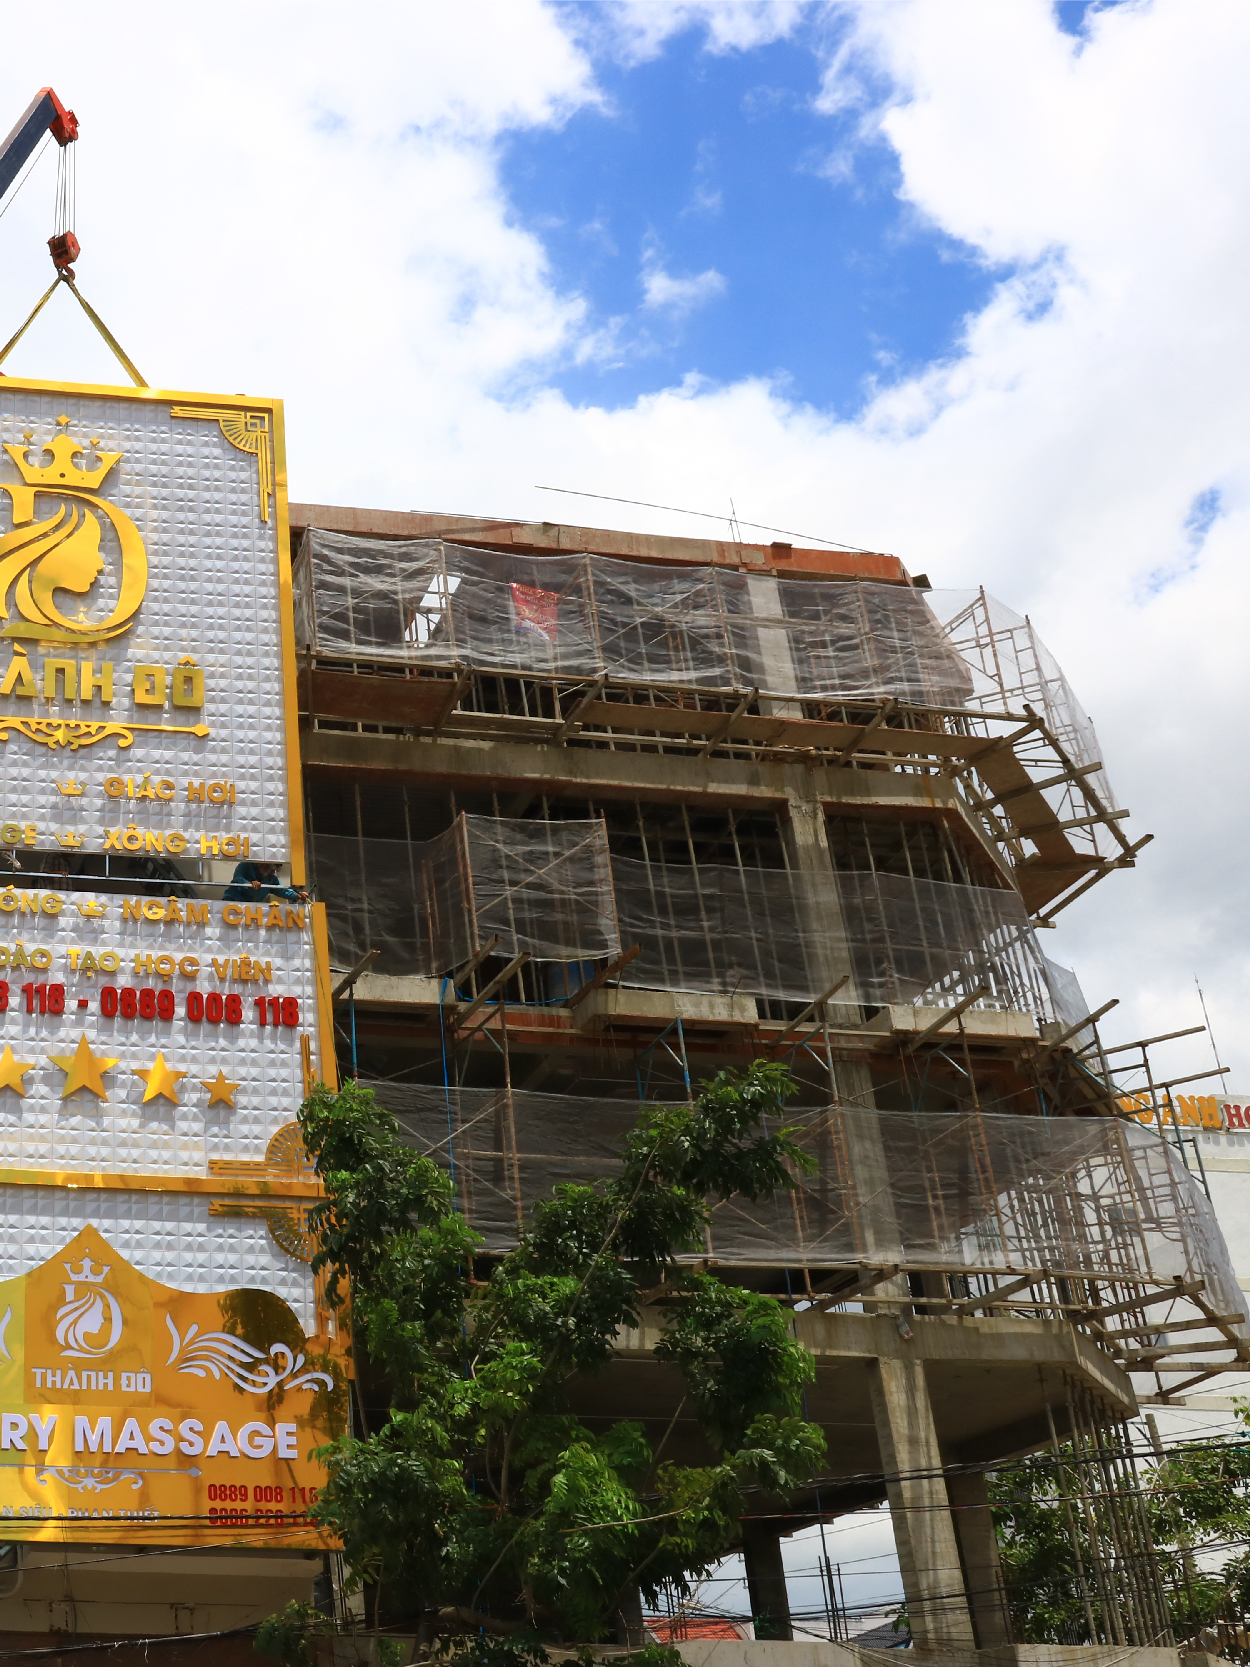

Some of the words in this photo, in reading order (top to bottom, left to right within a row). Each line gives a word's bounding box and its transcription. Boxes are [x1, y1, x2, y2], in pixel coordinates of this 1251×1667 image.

[133, 656, 204, 707] ĐÔ
[103, 772, 176, 800] GIÁC
[187, 780, 236, 804] HƠI
[102, 823, 188, 853] XÔNG
[200, 834, 250, 857] HƠI
[122, 896, 210, 924] NGÂM
[222, 901, 305, 928] CHÂN
[67, 948, 121, 977] TẠO
[134, 953, 200, 982] HỌC
[211, 953, 273, 981] VIÊN
[21, 982, 65, 1014] 118
[100, 986, 176, 1020] 0889
[187, 991, 243, 1024] 008
[254, 996, 299, 1026] 118
[1161, 1094, 1222, 1128] ANH
[31, 1362, 114, 1391] THÀNH
[120, 1367, 152, 1393] ĐÔ
[74, 1415, 299, 1460] MASSAGE
[208, 1483, 248, 1502] 0889
[253, 1485, 283, 1504] 008
[19, 1503, 53, 1518] SIÊU
[68, 1508, 114, 1521] PHAN
